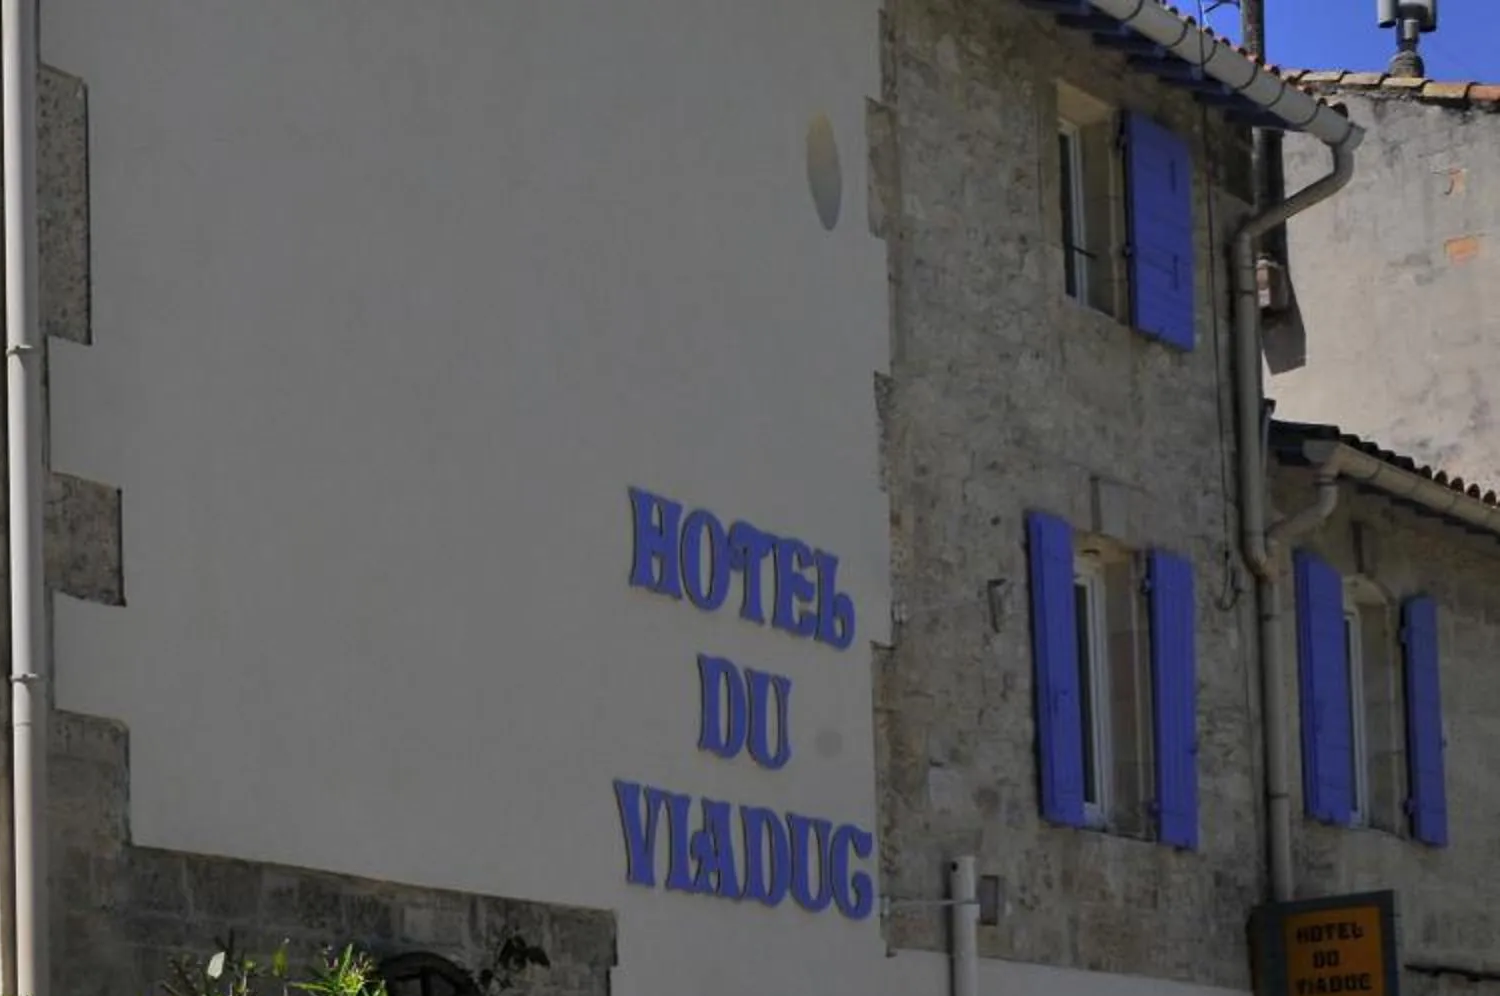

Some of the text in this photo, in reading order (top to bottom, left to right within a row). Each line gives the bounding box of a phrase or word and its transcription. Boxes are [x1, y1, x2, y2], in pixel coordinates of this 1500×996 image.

[628, 486, 856, 651] HOTEL
[697, 653, 792, 770] DU
[613, 778, 874, 920] VIADUC
[1296, 922, 1364, 944] HOTEL
